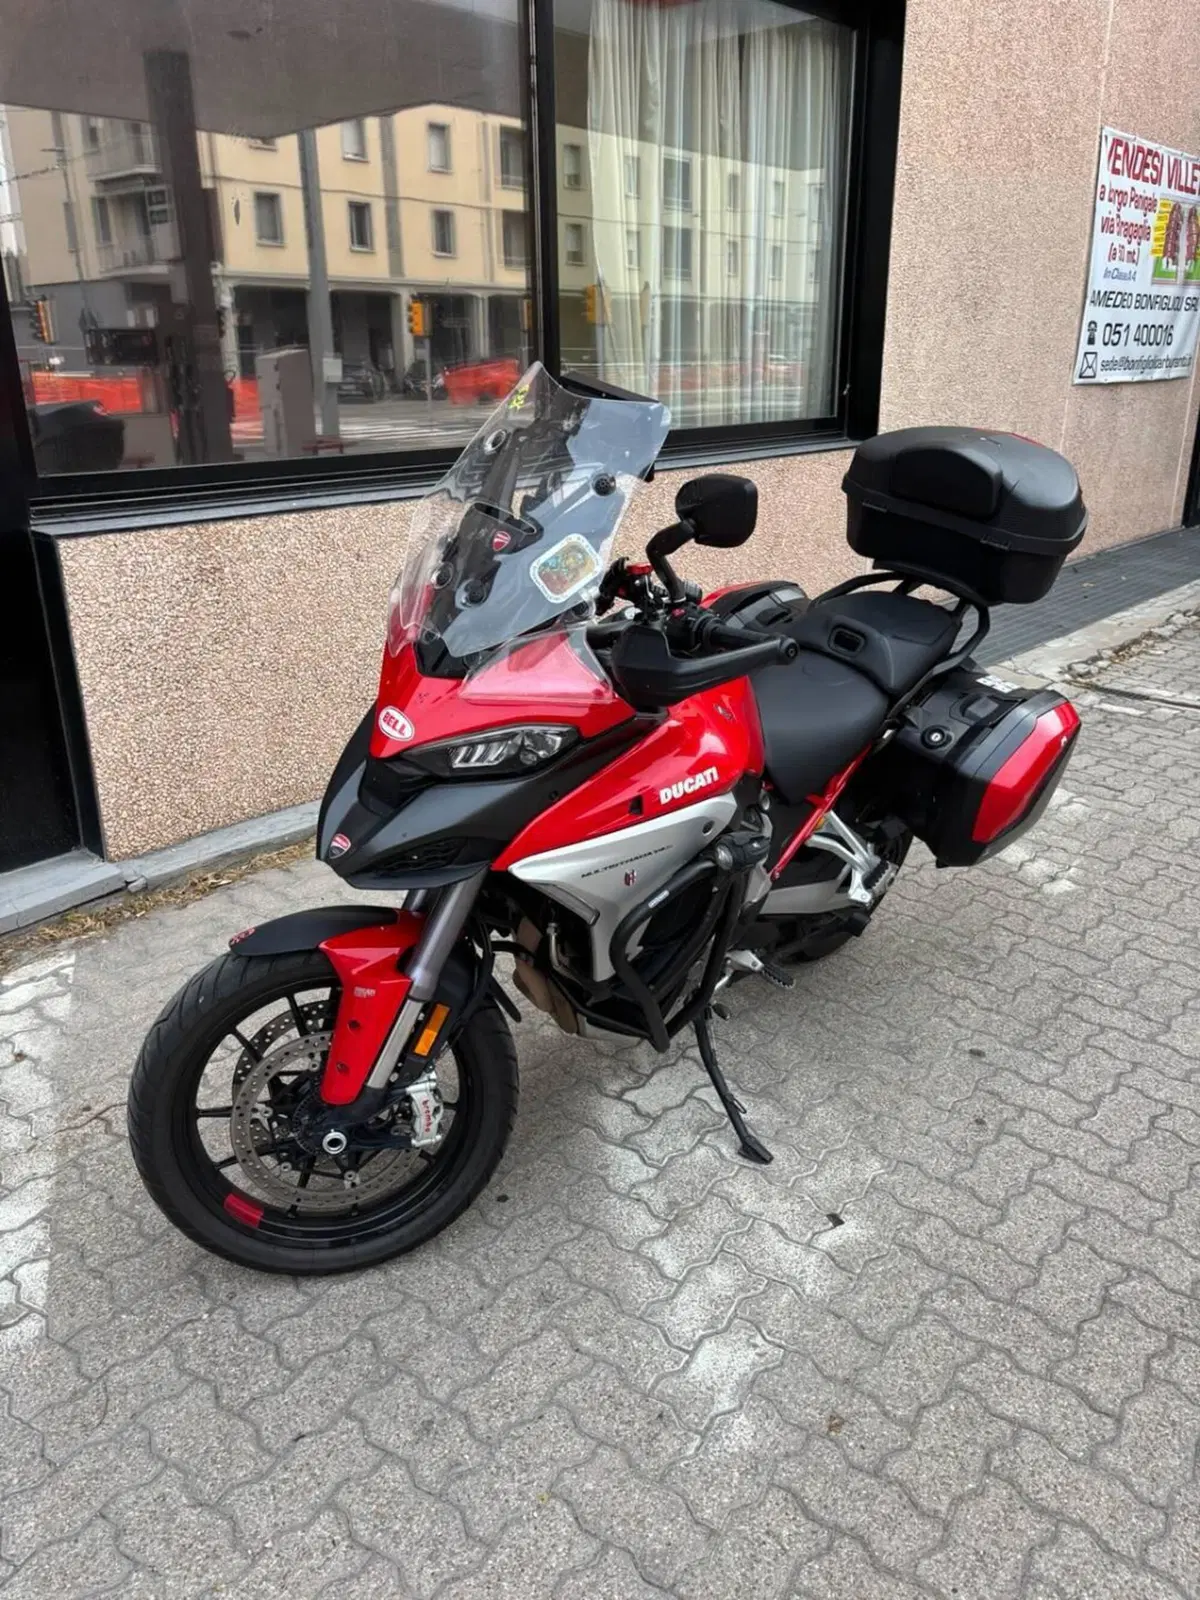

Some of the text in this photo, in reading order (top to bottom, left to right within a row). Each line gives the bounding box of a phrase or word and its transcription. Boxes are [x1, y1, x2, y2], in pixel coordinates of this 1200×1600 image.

[1104, 135, 1200, 197] VENDESI VILLE
[1099, 184, 1106, 202] a
[1129, 186, 1158, 217] Panigale
[1101, 210, 1115, 235] via
[1089, 290, 1132, 309] AMEDEO
[1102, 322, 1174, 347] 051 400016
[382, 712, 406, 736] BELL
[659, 766, 720, 805] DUCATI
